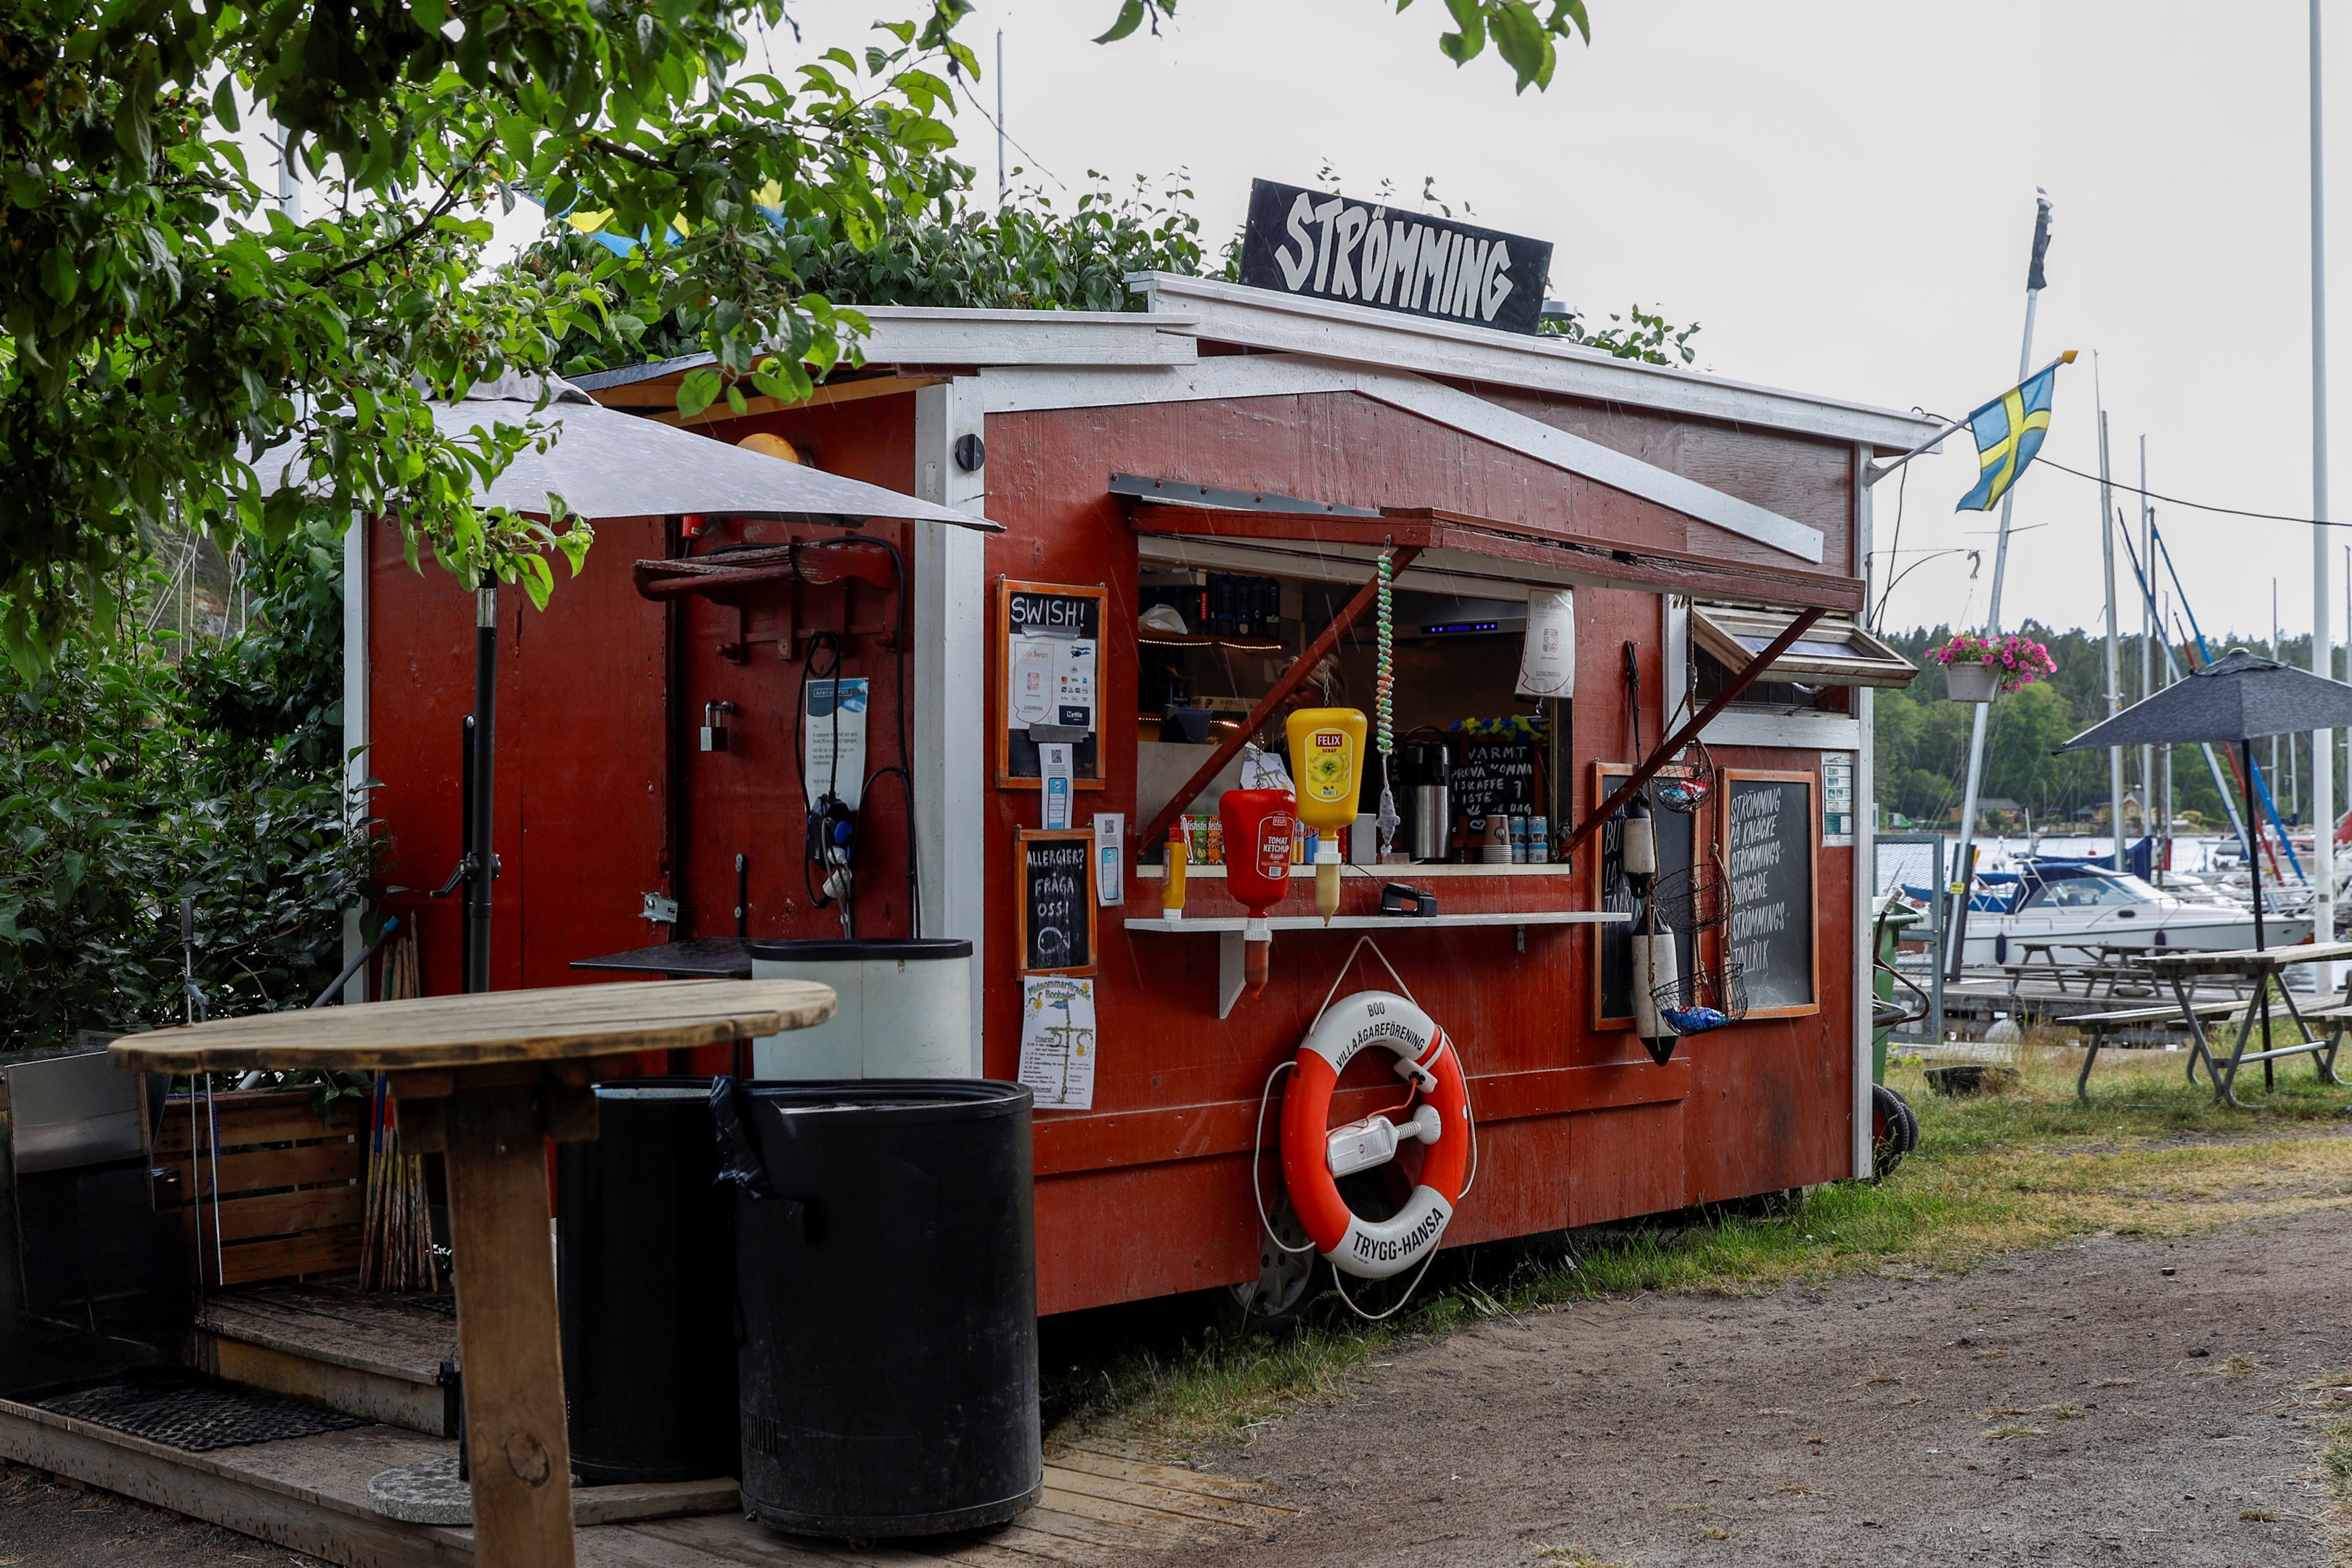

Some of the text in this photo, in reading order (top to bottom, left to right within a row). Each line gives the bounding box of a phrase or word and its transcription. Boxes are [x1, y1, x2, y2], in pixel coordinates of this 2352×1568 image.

[1275, 192, 1514, 322] STRÖMMING
[1010, 596, 1085, 627] SWISH!
[1318, 735, 1341, 746] FELIX
[1469, 746, 1527, 760] VARMT
[1509, 804, 1532, 815] DAG
[1731, 786, 1781, 825] STRÖMMING
[1268, 836, 1288, 845] TOMAT
[1730, 814, 1778, 850] PÅ KNÄCKE
[1026, 849, 1085, 870] ALLERGIER?
[1263, 844, 1289, 853] KETCHUP
[1034, 872, 1074, 897] FRÅGA
[1733, 871, 1768, 905] BURGARE
[1037, 901, 1069, 924] OSS!
[1027, 980, 1091, 1001] Midsommarfirande
[1045, 989, 1077, 1000] Boobadet
[1367, 1002, 1385, 1017] BOO
[1336, 1020, 1426, 1069] VILLAÄGAREFÖRENING
[1352, 1207, 1445, 1261] TRYGG-HANSA
